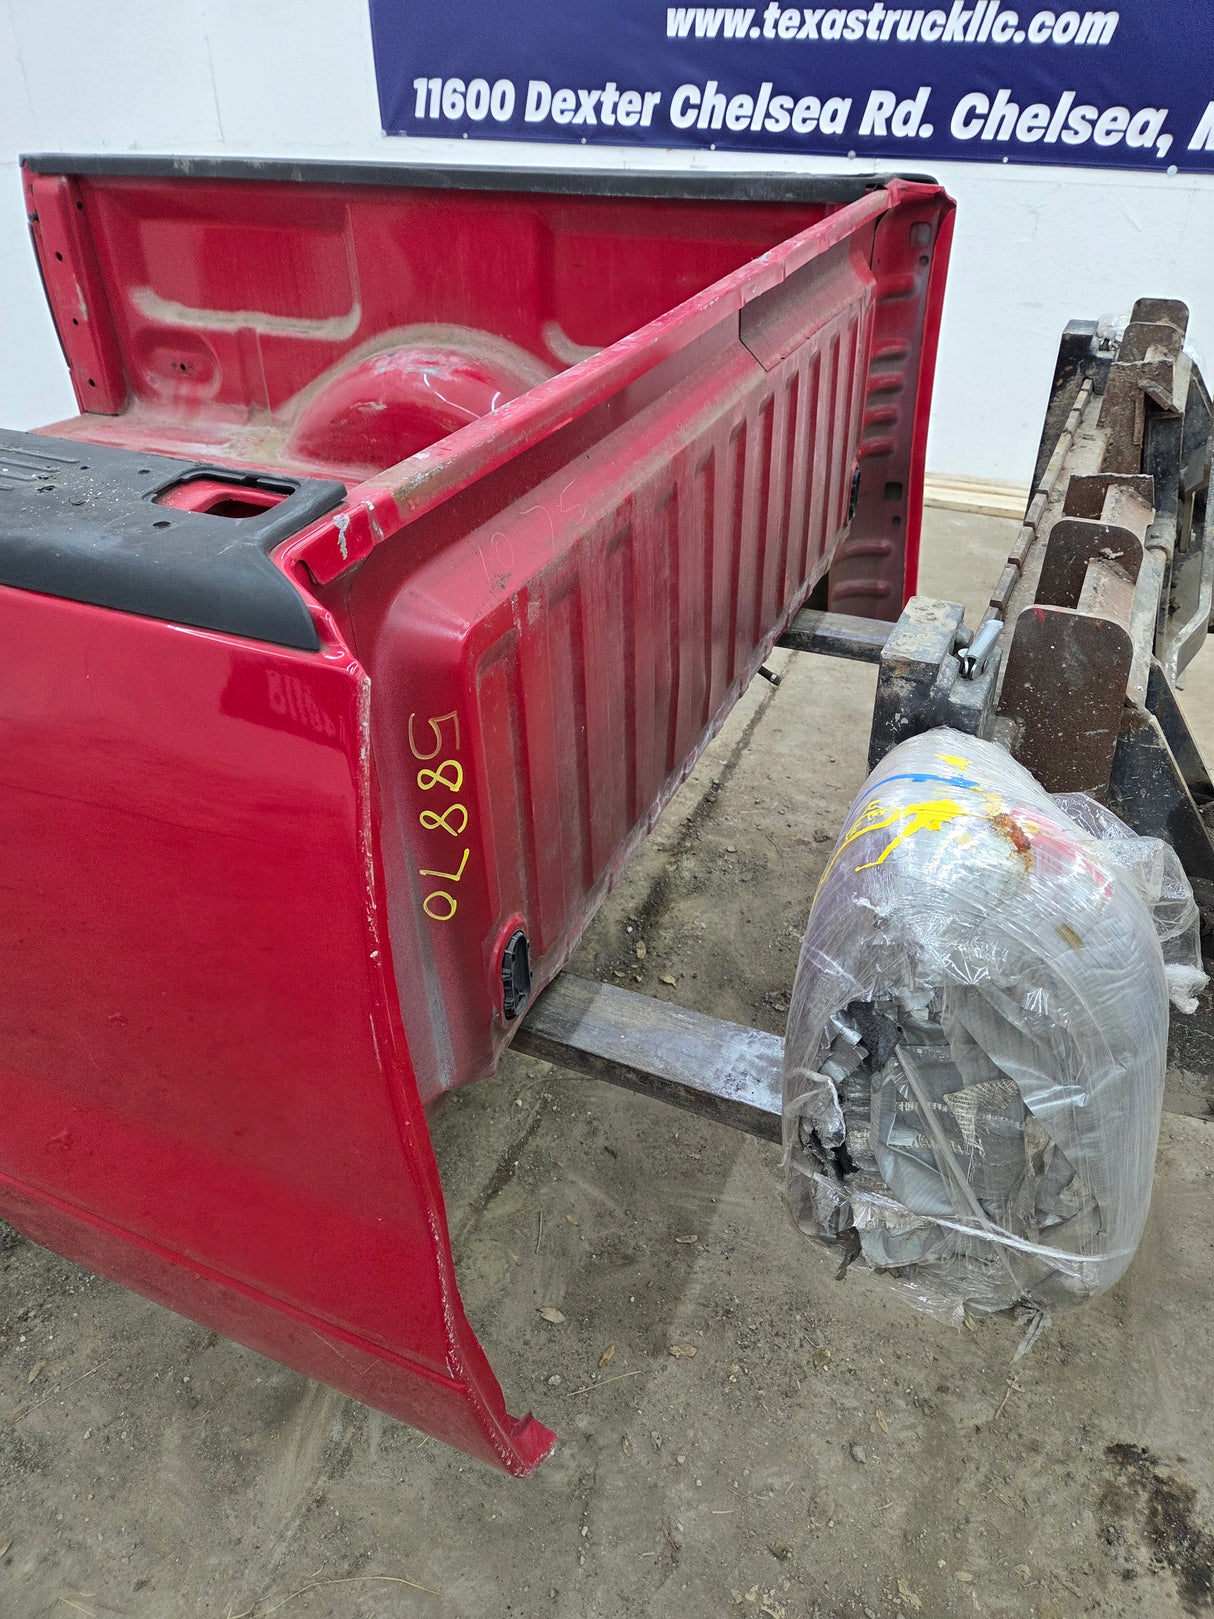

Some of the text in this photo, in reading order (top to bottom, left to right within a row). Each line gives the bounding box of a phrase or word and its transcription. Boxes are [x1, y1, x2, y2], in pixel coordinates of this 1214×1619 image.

[666, 0, 1120, 46] www.texastruckllc.com
[413, 77, 516, 122] 11600
[524, 80, 662, 127] Dexter
[670, 80, 853, 135] Chelsea
[858, 86, 935, 139] Rd.
[950, 88, 1174, 158] Chelsea,
[408, 709, 470, 921] 58870
